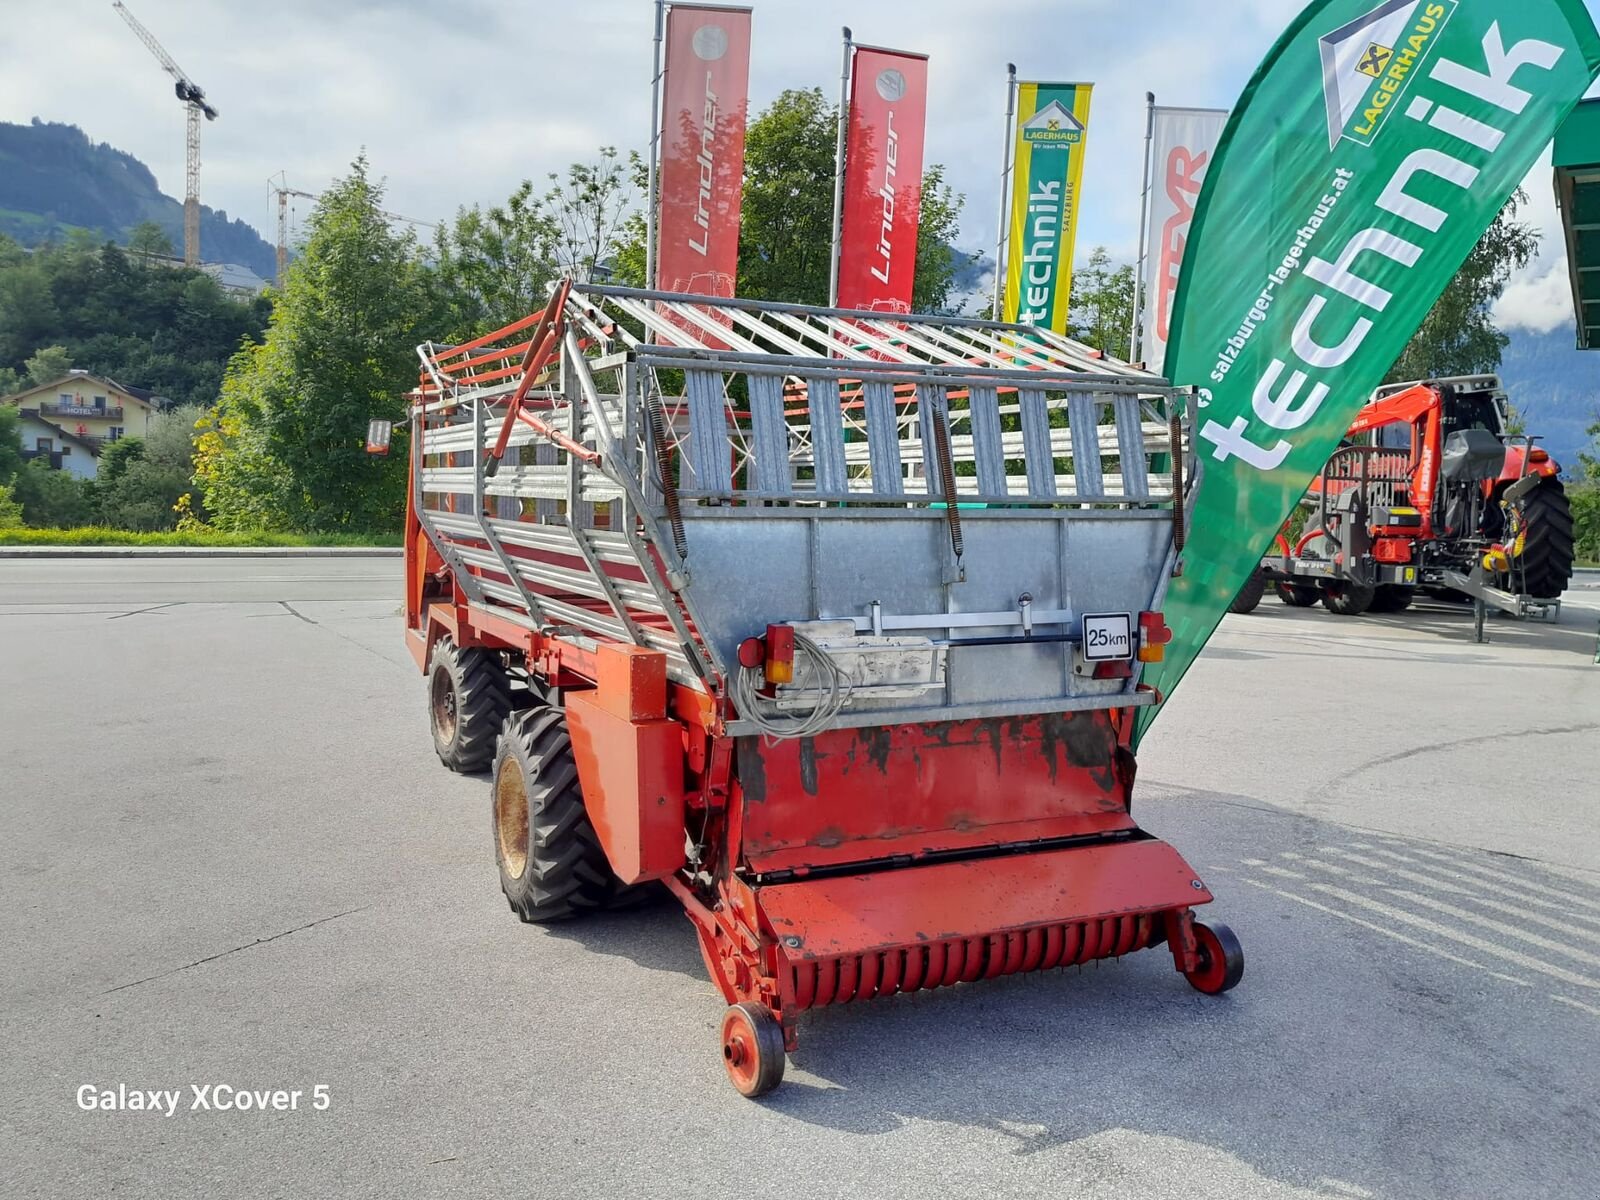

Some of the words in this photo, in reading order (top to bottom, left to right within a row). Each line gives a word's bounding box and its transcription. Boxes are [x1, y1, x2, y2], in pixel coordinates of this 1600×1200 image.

[1026, 131, 1079, 141] LAGERHAUS
[1354, 3, 1444, 136] LAGERHAUS
[689, 71, 720, 256] Lindner
[871, 111, 900, 285] Lindner
[1062, 181, 1074, 232] SALZBURG
[1019, 180, 1060, 327] technik
[1199, 19, 1565, 471] technik
[1210, 167, 1354, 383] salzburger-lagerhaus.at
